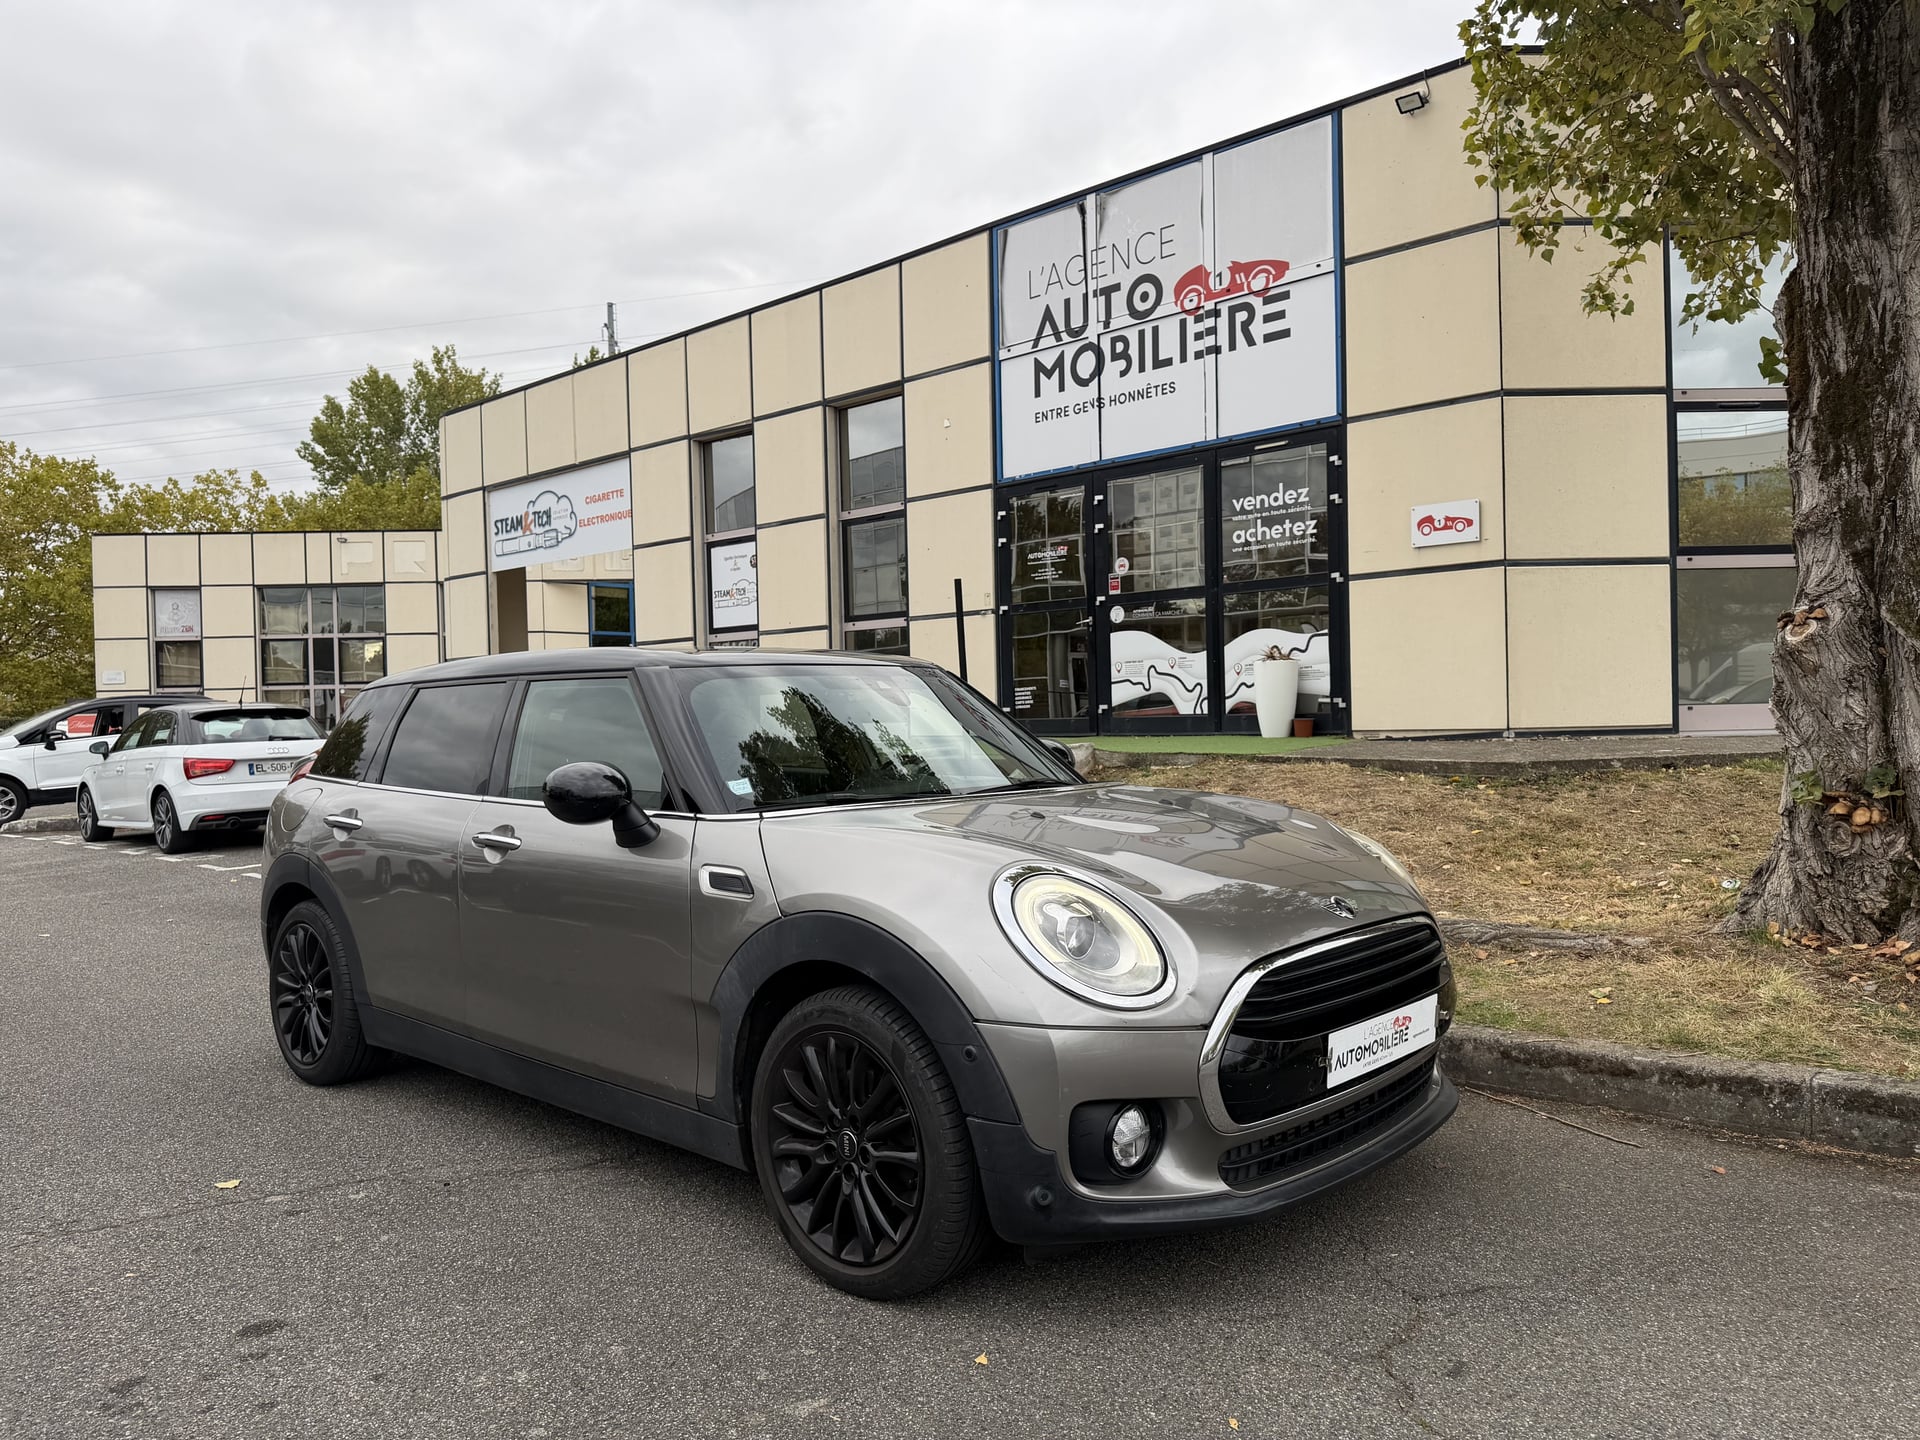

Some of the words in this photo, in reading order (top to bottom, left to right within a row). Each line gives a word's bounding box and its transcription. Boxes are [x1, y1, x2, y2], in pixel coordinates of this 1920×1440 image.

[1029, 224, 1176, 300] L'AGENCE
[1031, 273, 1164, 350] AUTO
[1034, 405, 1070, 424] ENTRE
[1073, 396, 1106, 415] GENS
[1109, 381, 1177, 407] HONNÊTES
[585, 488, 625, 505] CIGARETTE
[1232, 482, 1310, 512] vendez
[579, 508, 632, 528] ELECTRONIQUE
[1232, 519, 1318, 544] achetez
